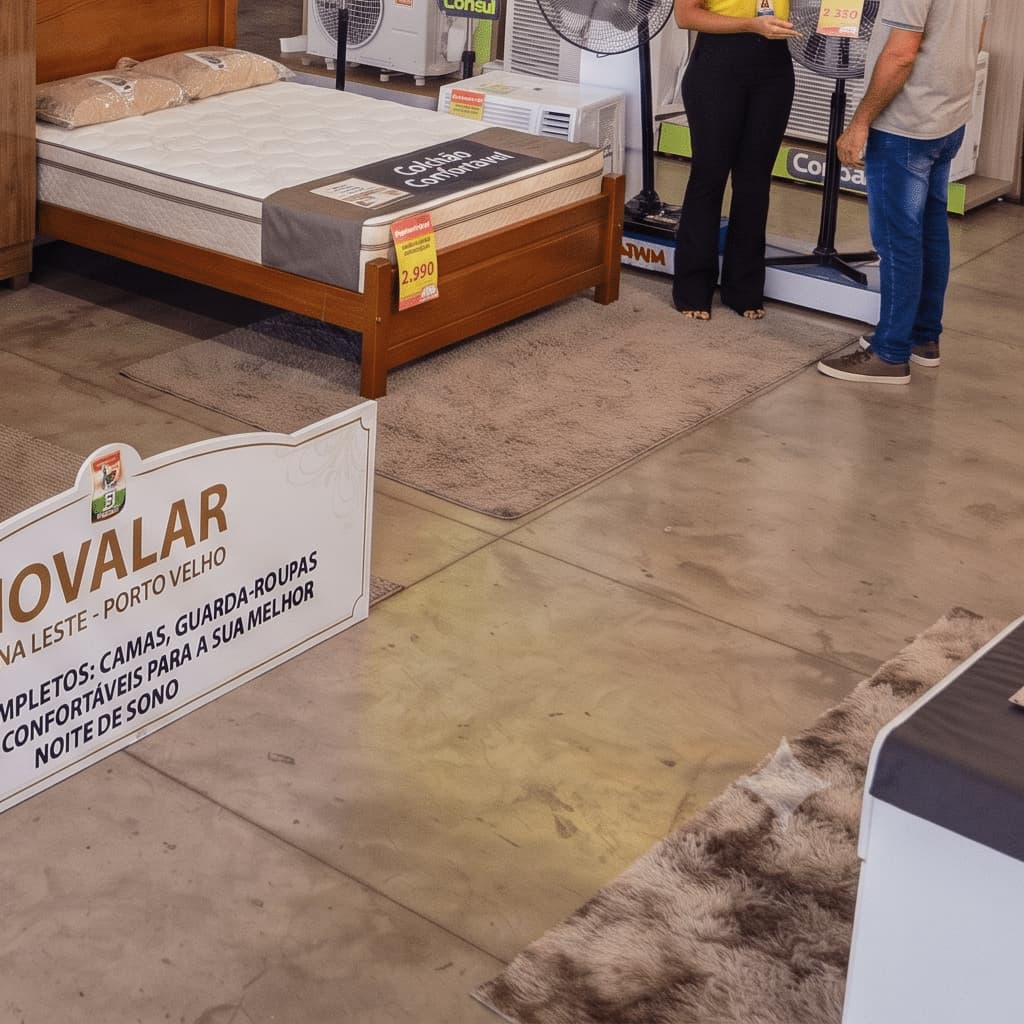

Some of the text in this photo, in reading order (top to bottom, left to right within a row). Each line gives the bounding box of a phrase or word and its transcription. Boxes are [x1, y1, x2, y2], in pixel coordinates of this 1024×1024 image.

[393, 150, 473, 176] Colchão
[401, 261, 434, 285] 2.990
[31, 609, 87, 654] LESTE
[104, 574, 166, 619] PORTO
[169, 546, 226, 587] VELHO
[99, 625, 171, 674] CAMAS,
[175, 550, 318, 637] GUARDA-ROUPAS
[2, 667, 143, 753] CONFORTÁVEIS
[147, 643, 192, 682] PARA
[196, 635, 208, 658] A
[212, 616, 244, 649] SUA
[247, 580, 314, 631] MELHOR
[35, 678, 179, 769] NOITE DE SONO
